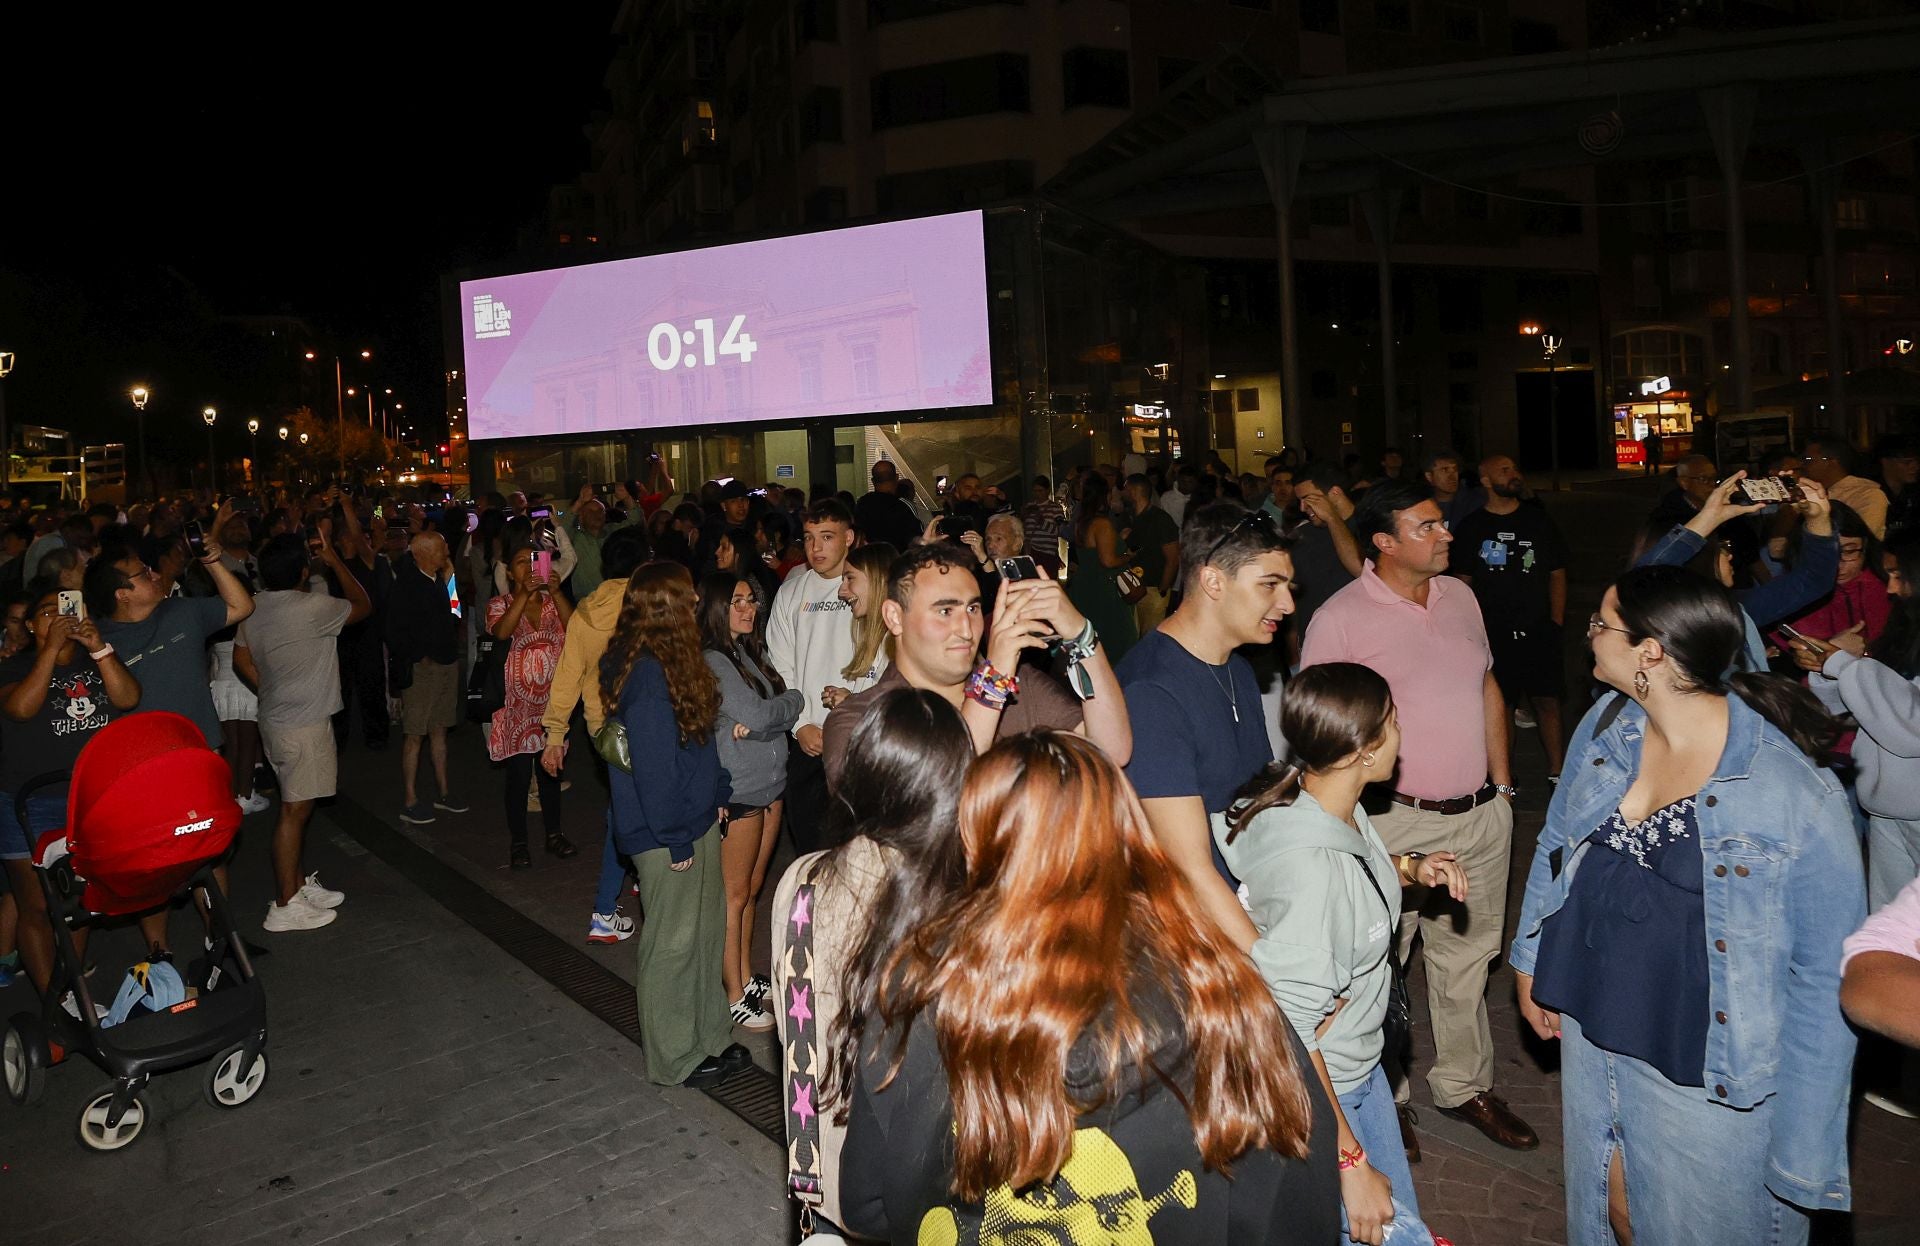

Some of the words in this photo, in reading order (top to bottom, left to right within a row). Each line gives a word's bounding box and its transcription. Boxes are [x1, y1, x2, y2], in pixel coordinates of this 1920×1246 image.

[647, 314, 757, 371] 0:14
[51, 719, 78, 736] THE
[174, 818, 214, 836] STOKKE
